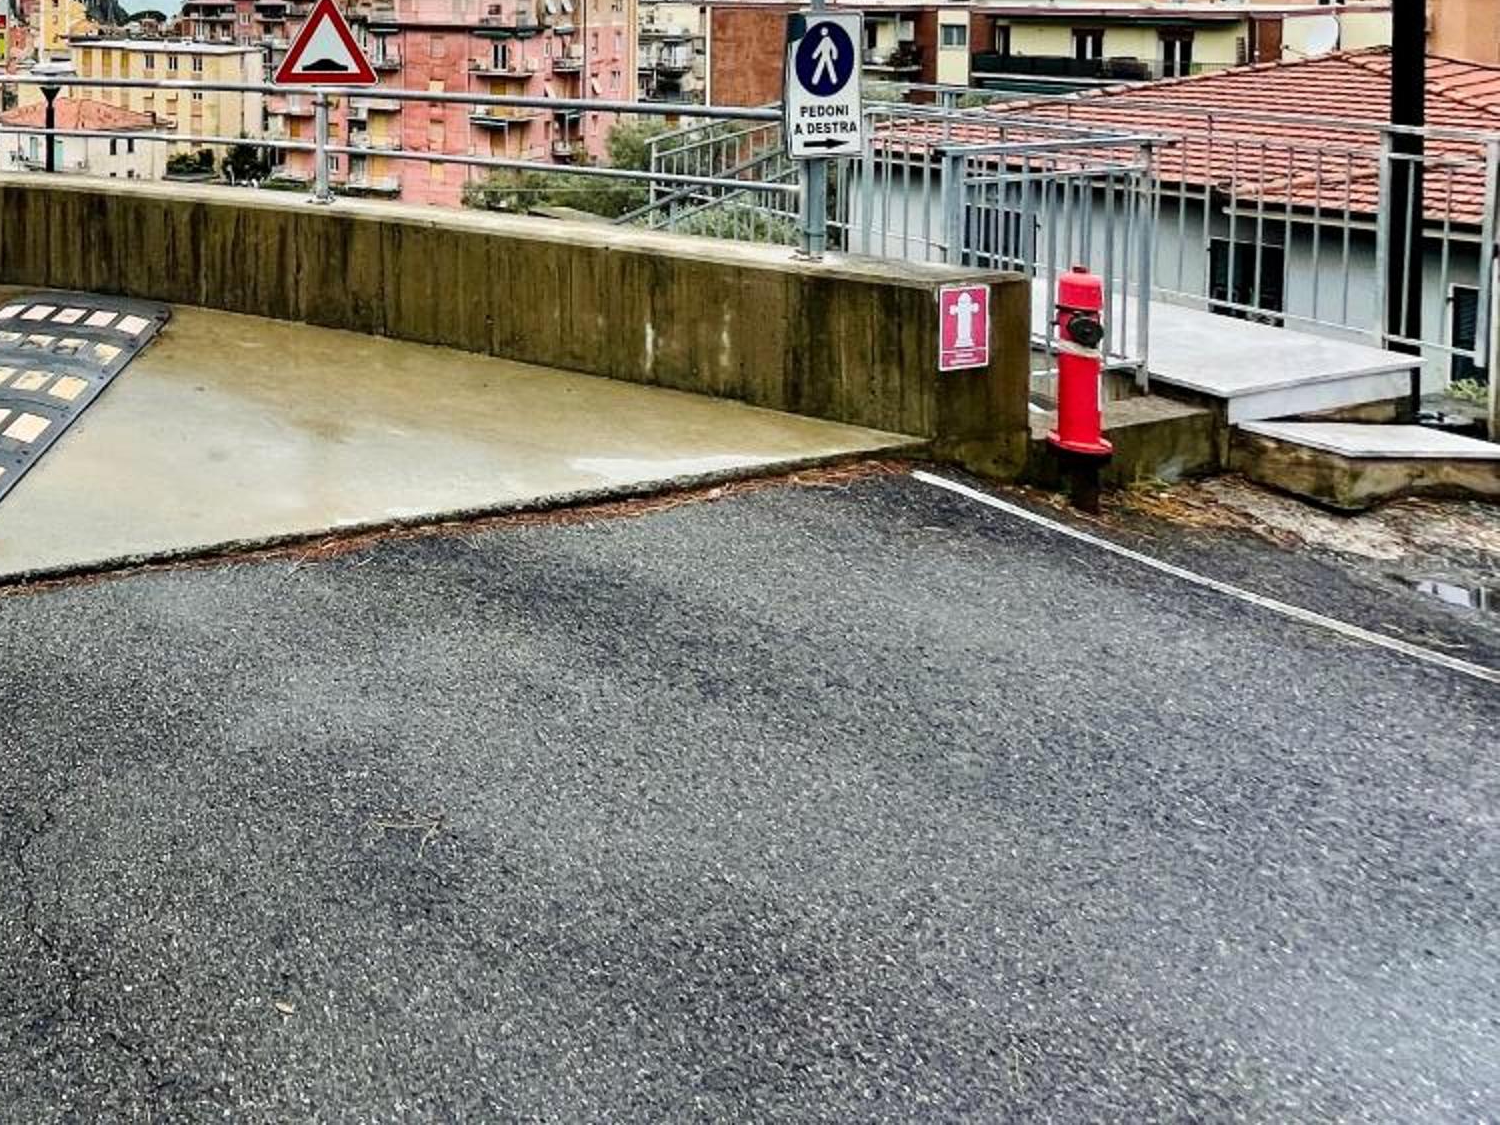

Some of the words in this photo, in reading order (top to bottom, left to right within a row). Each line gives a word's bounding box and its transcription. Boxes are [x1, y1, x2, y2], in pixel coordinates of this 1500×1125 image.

[800, 104, 849, 118] PEDONI
[794, 122, 804, 135] A
[806, 121, 857, 135] DESTRA
